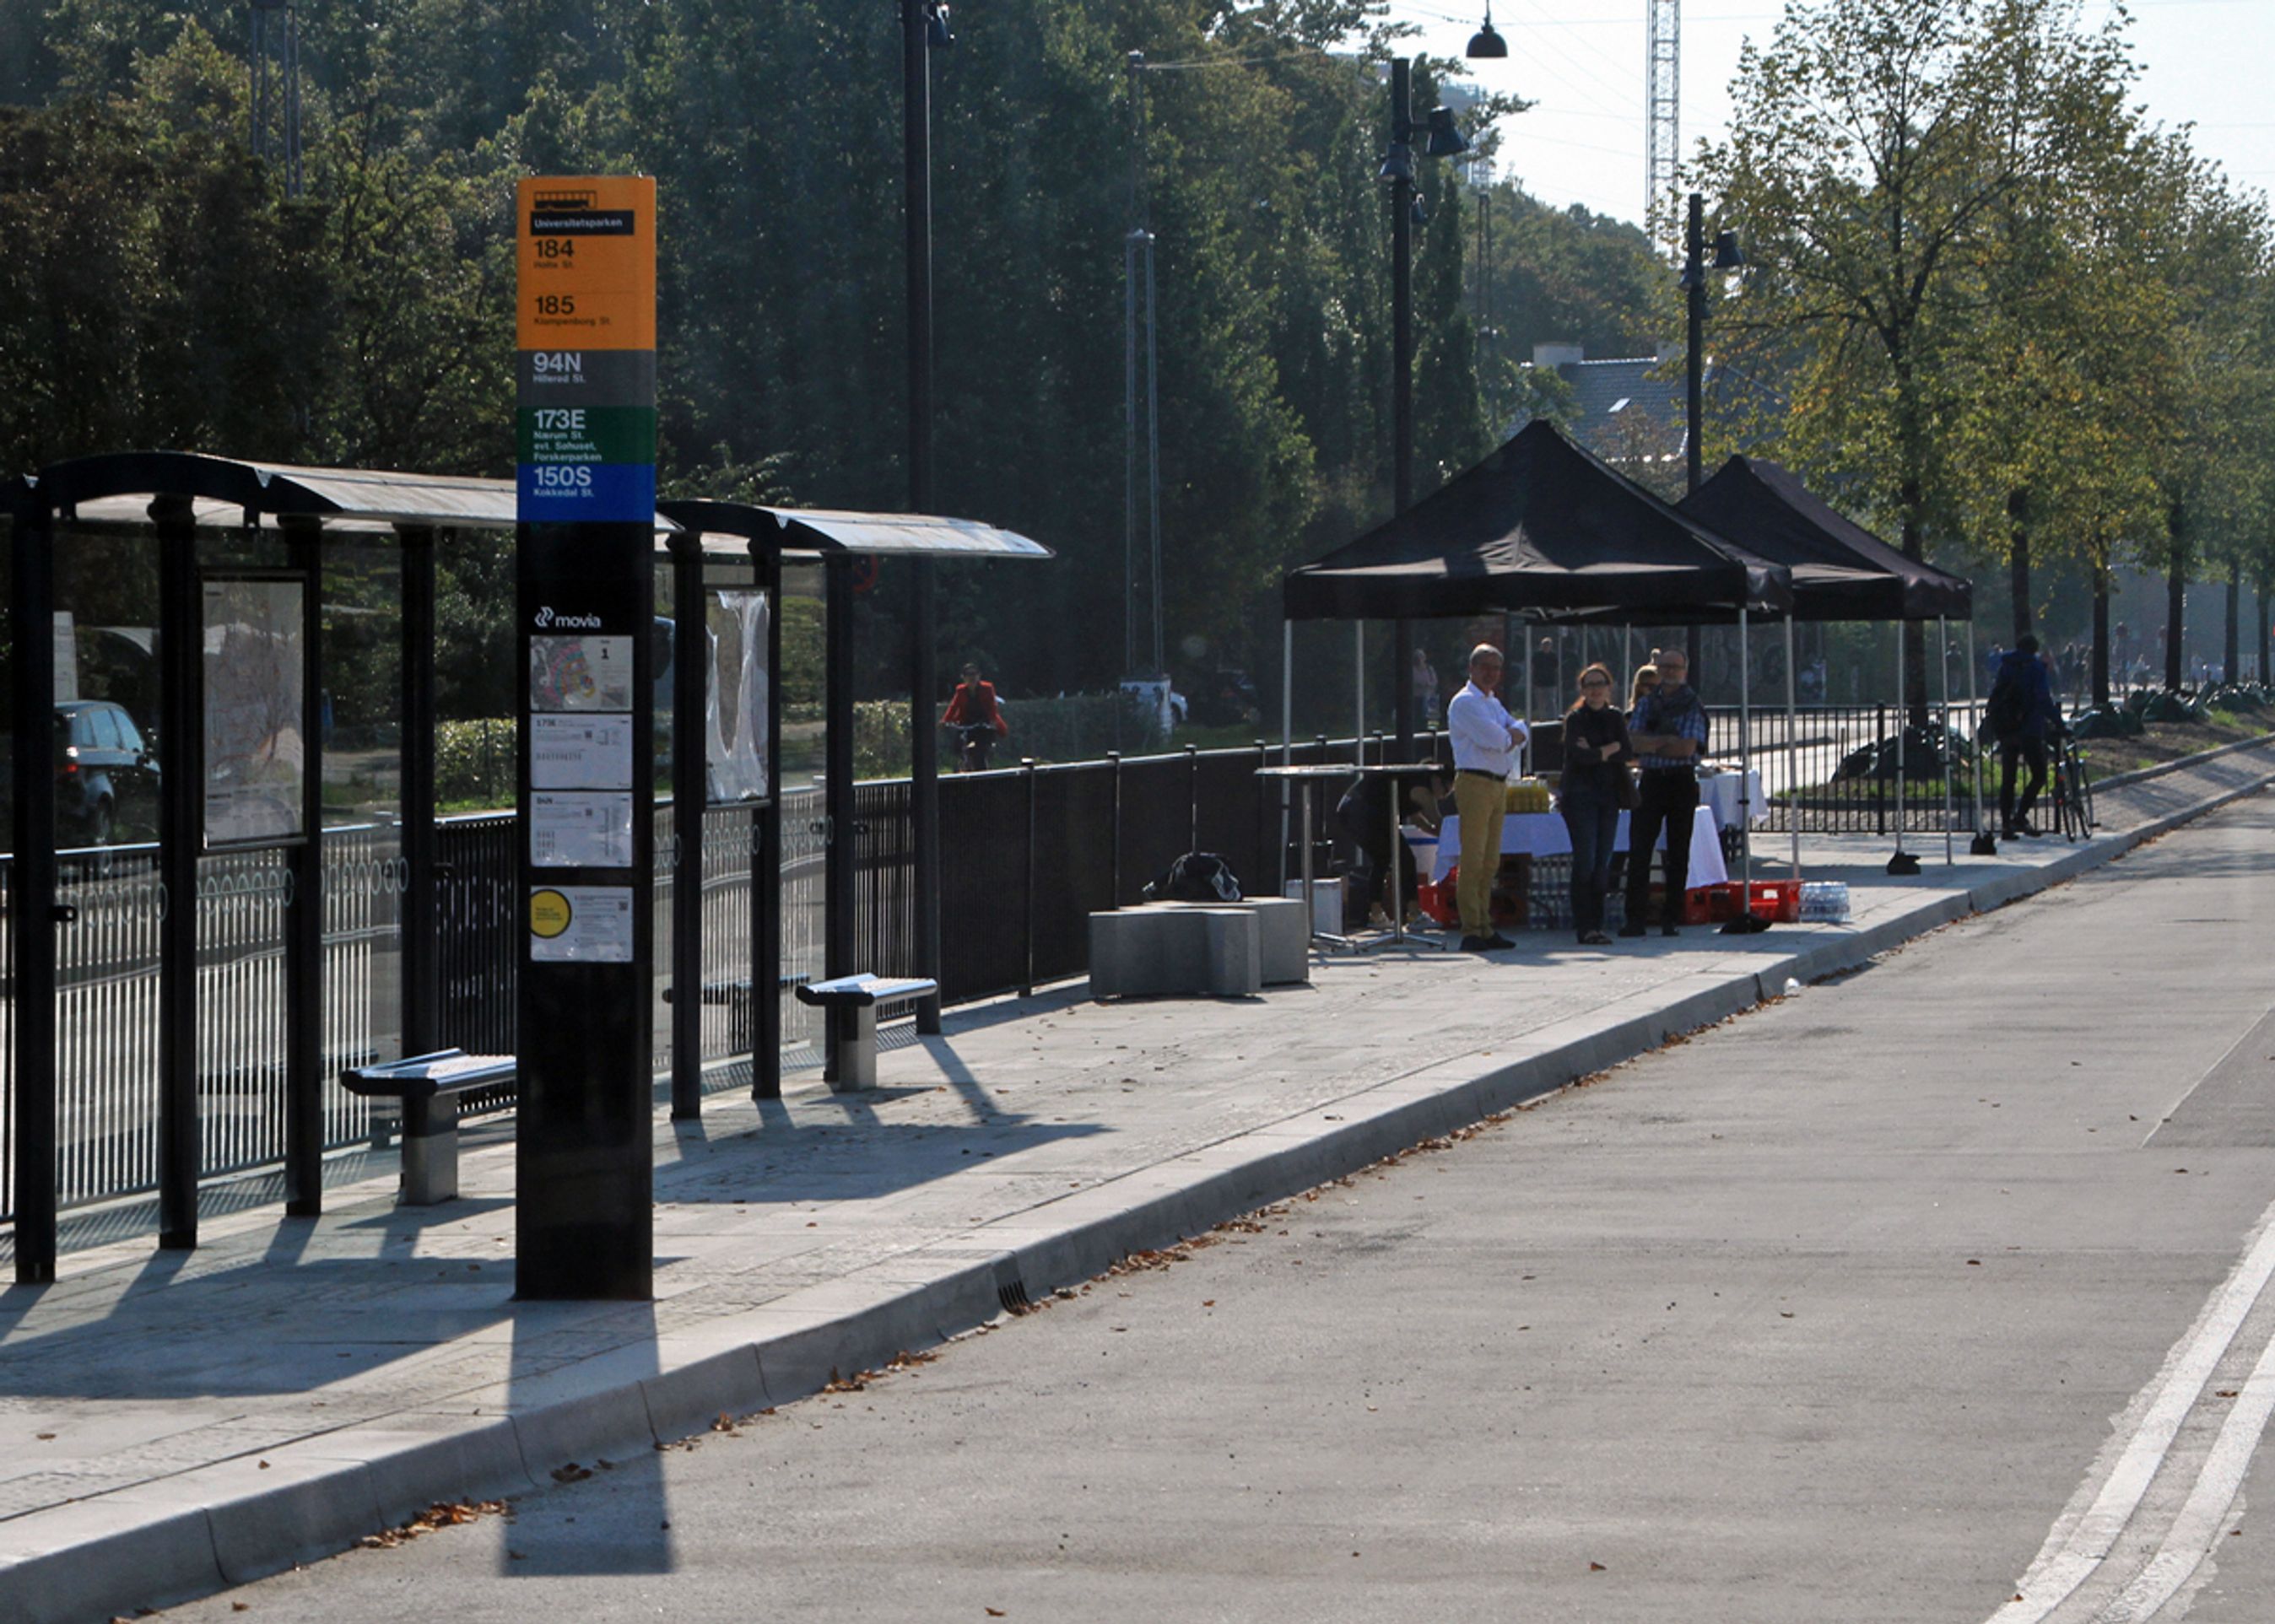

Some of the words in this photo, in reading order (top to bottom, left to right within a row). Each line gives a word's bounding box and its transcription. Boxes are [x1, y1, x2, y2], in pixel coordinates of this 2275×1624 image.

[534, 219, 623, 229] Universitetsparken
[534, 239, 574, 258] 184
[535, 295, 575, 315] 185
[533, 352, 581, 373] 94N
[534, 409, 586, 429] 173E
[533, 453, 602, 462] Forskerparken
[534, 466, 592, 487] 150S
[533, 488, 578, 497] Kokkedal
[555, 612, 602, 628] movia
